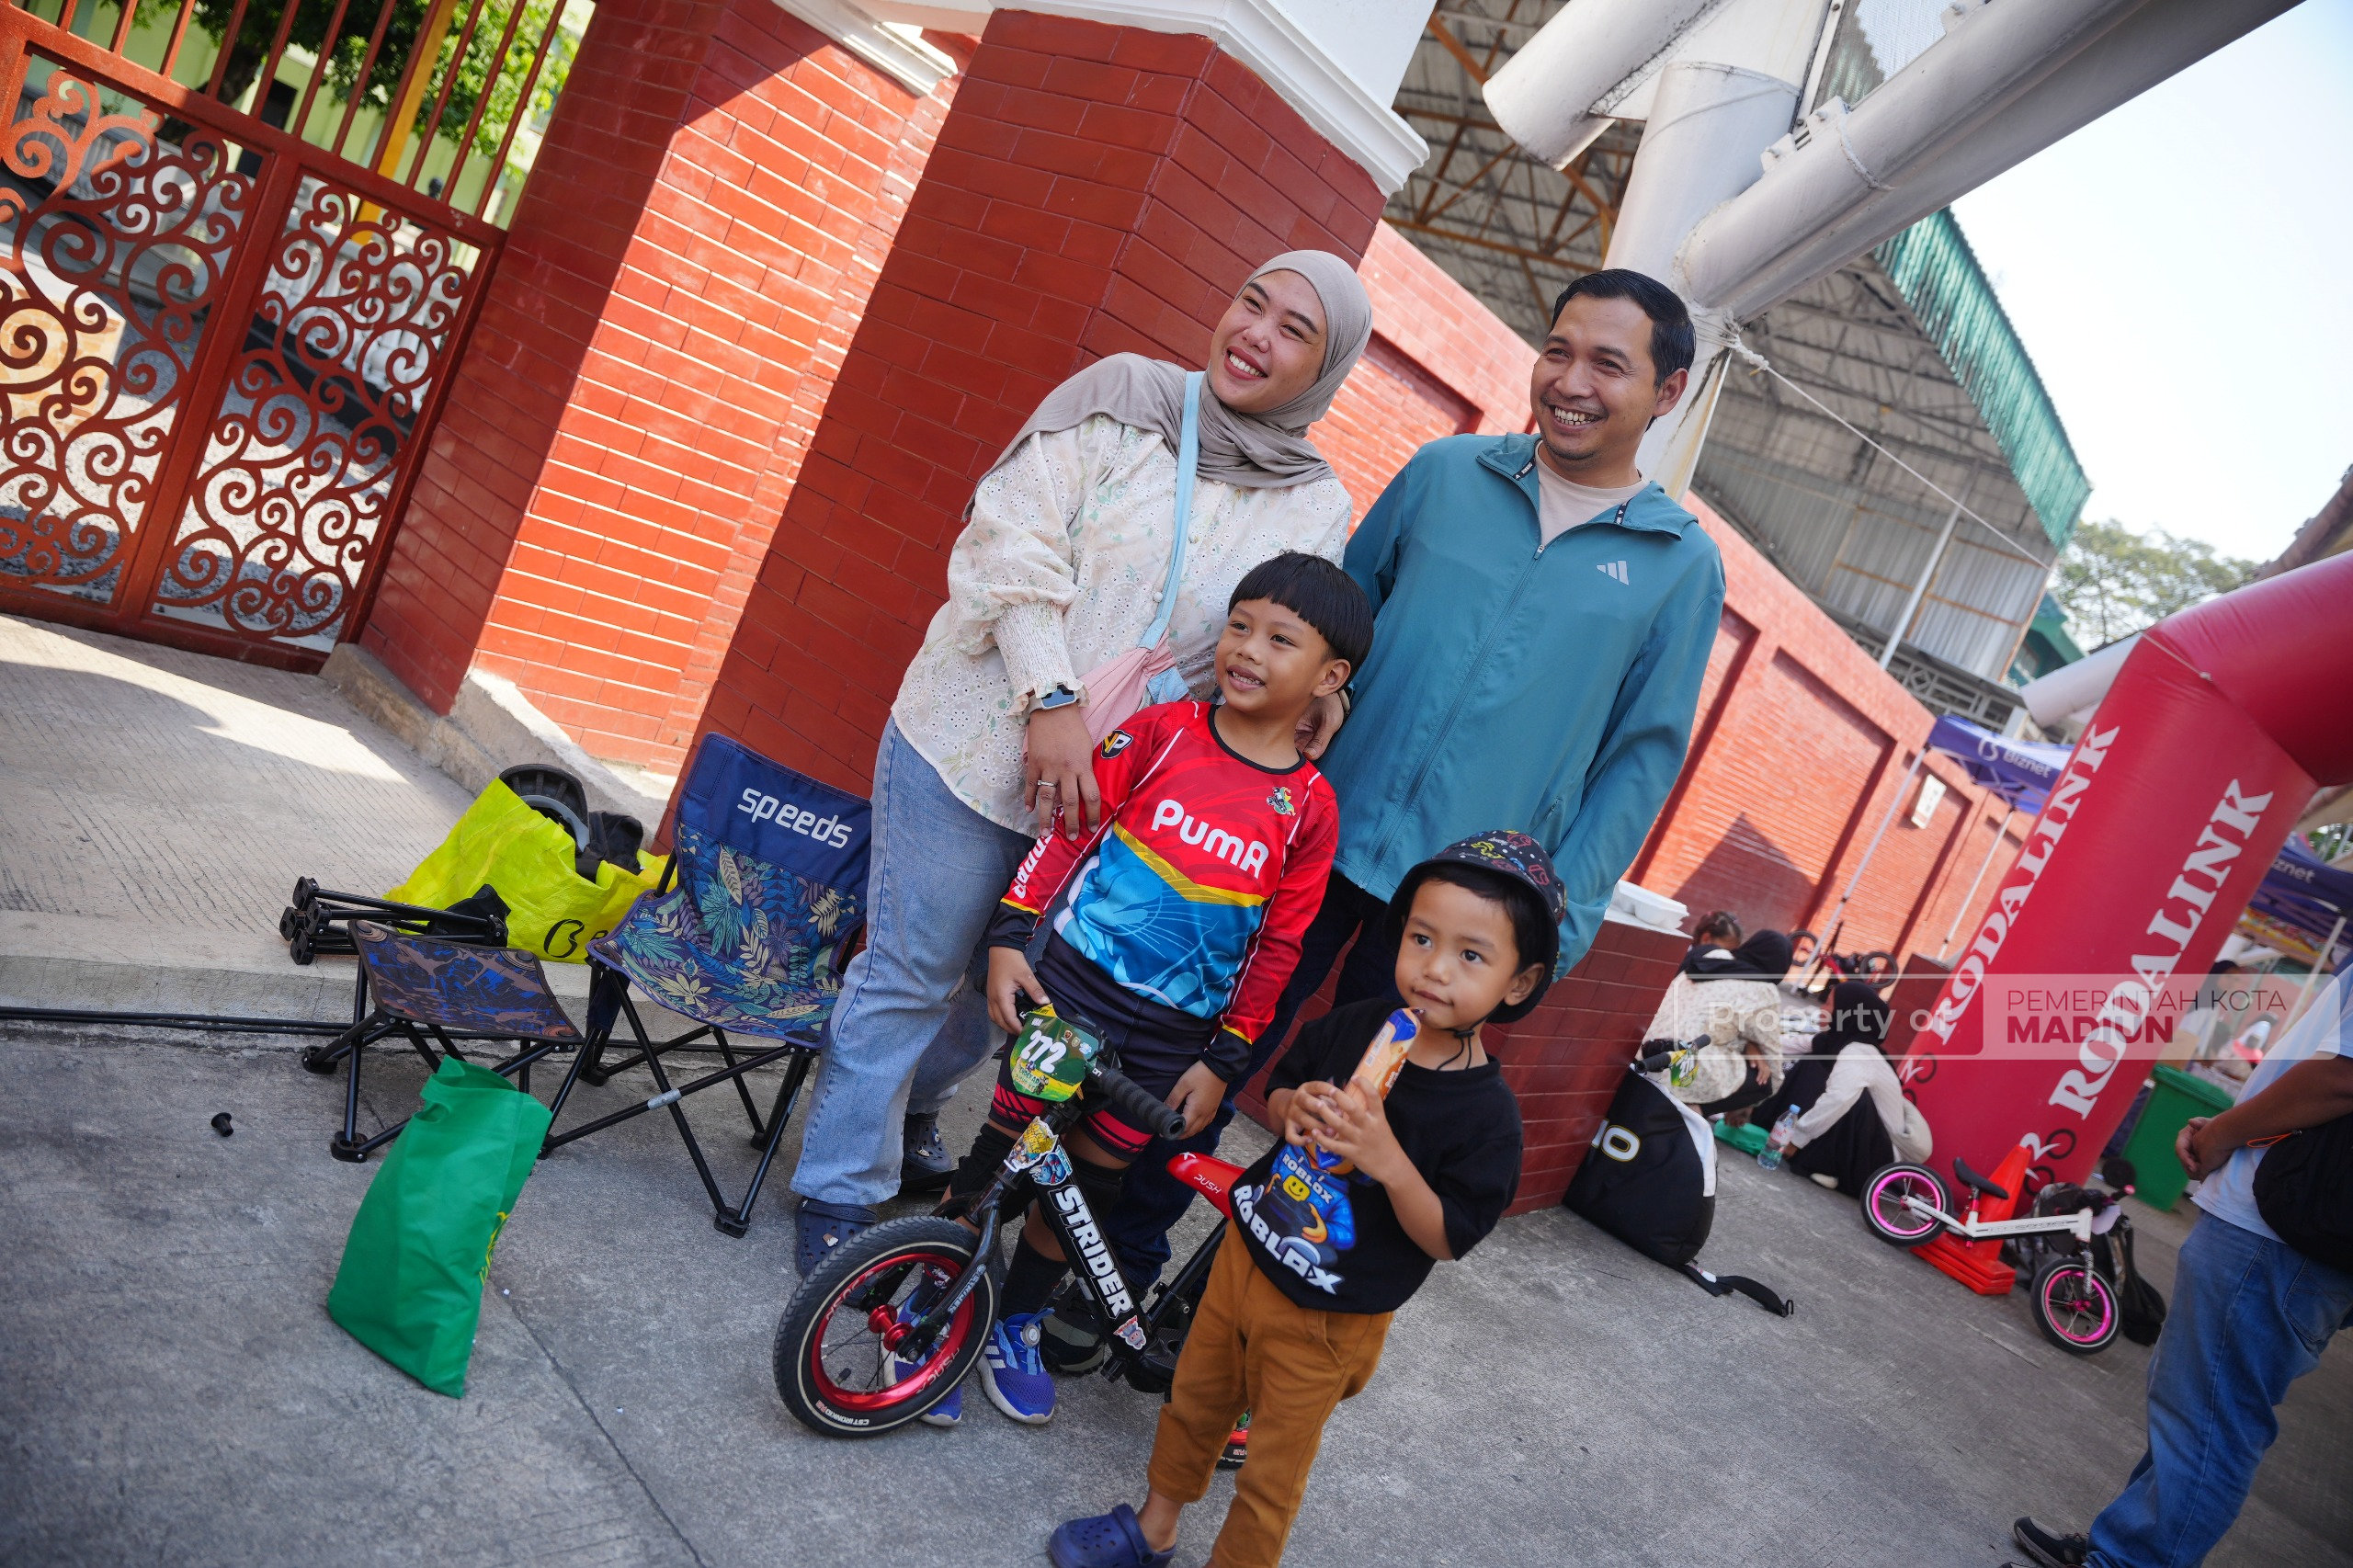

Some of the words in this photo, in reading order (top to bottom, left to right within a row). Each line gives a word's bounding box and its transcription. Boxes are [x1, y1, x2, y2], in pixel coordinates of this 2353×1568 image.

[2003, 749, 2052, 778] Biznet
[737, 788, 853, 849] speeds
[1151, 799, 1269, 880] PUMA
[1927, 724, 2120, 1045] RODALINK
[2048, 778, 2274, 1121] RODALINK
[1020, 1029, 1067, 1074] 272
[1282, 1153, 1334, 1204] ROBLOX
[1054, 1186, 1134, 1318] STRIDER
[1234, 1185, 1342, 1295] ROBLOX
